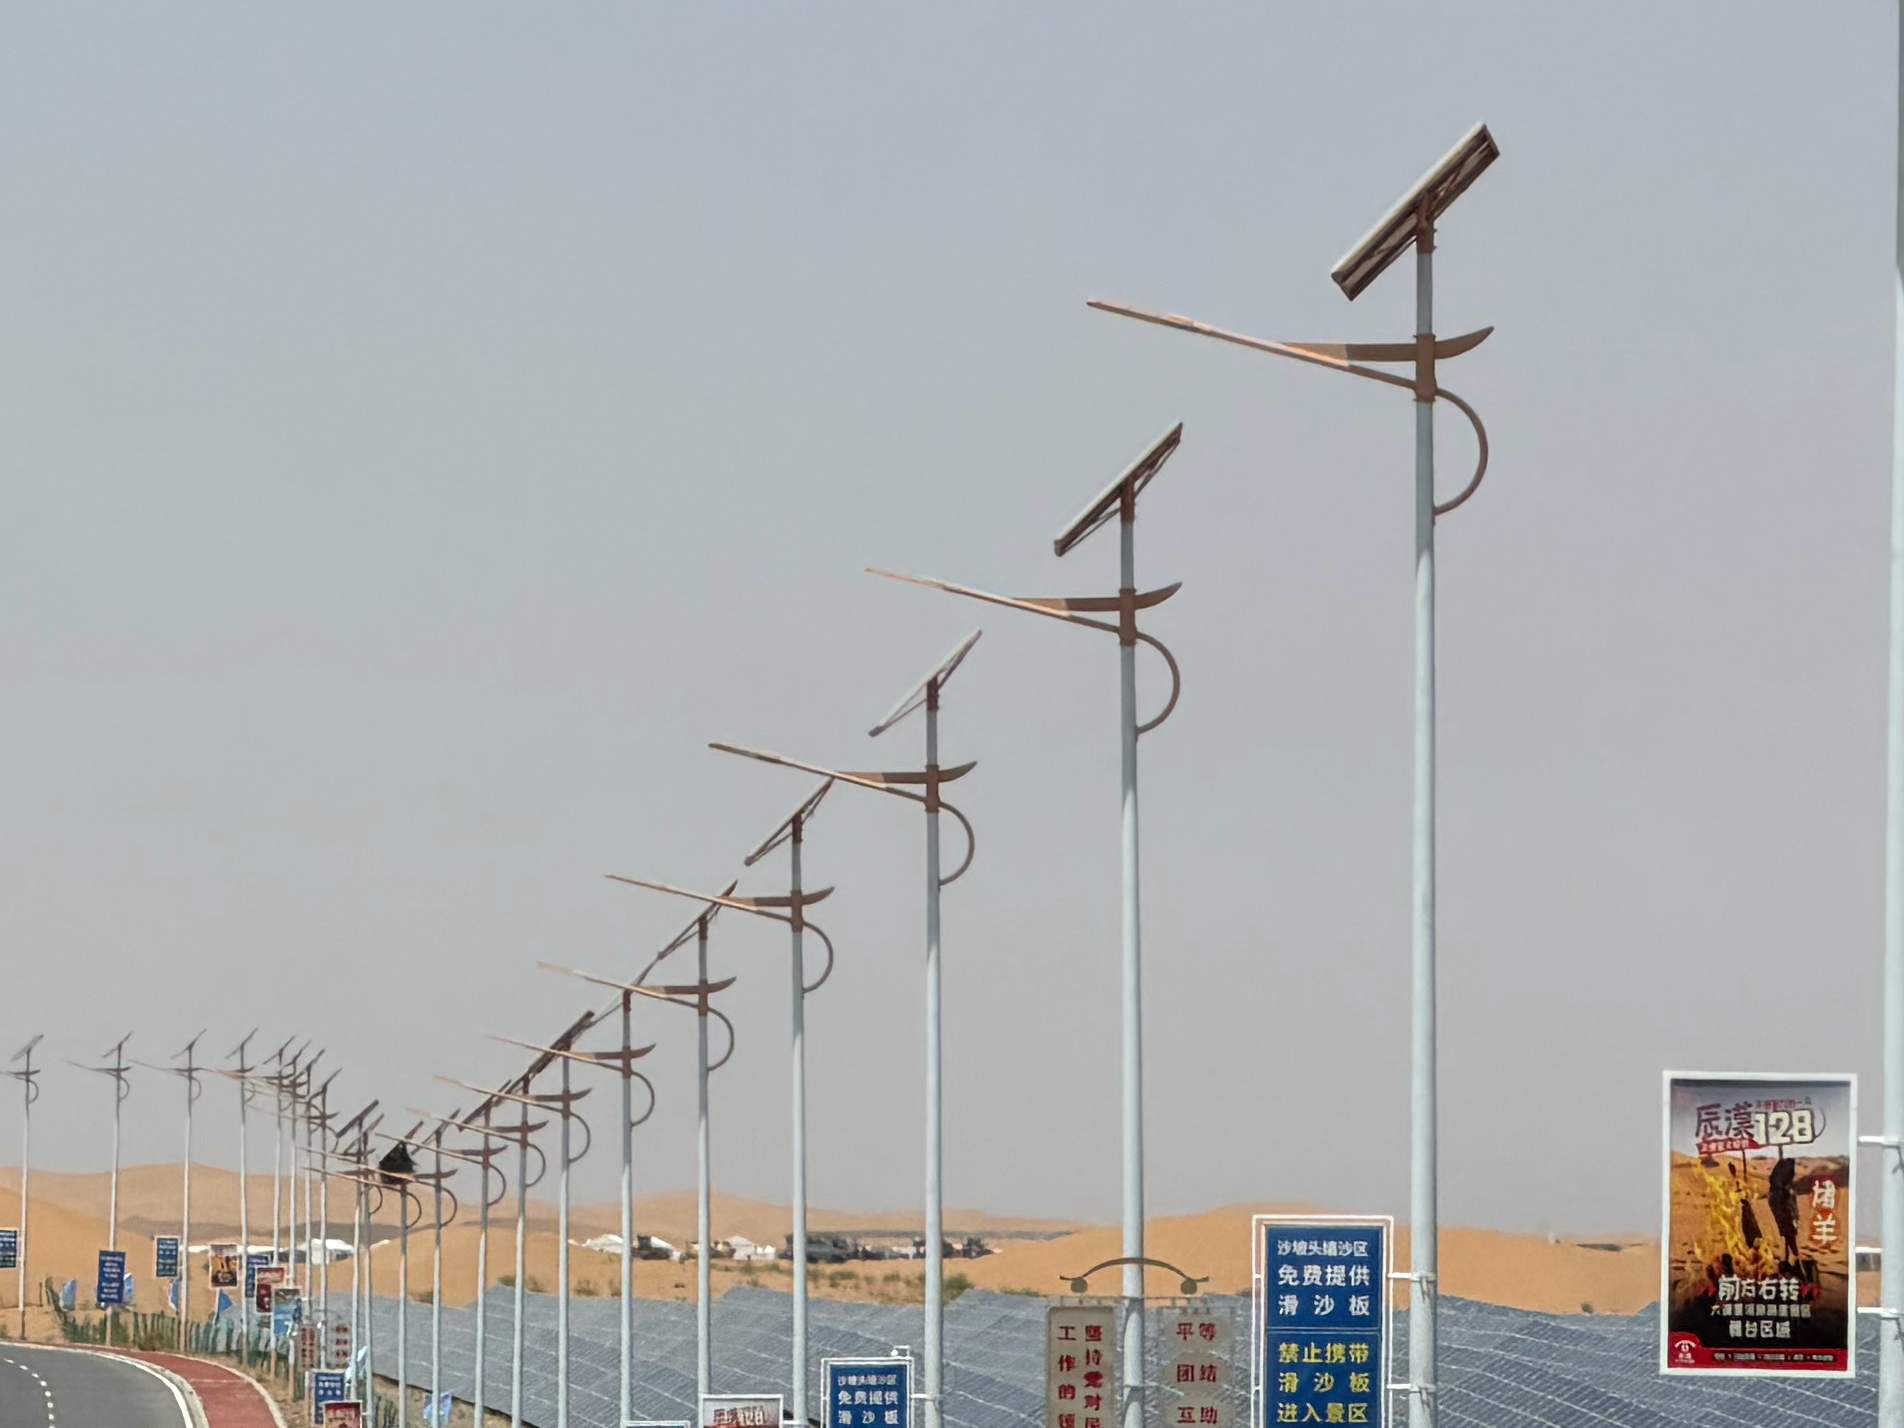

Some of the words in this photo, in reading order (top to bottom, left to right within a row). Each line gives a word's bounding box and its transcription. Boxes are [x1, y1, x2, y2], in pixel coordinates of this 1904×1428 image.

[1277, 1264, 1371, 1287] 免费提供
[1718, 1274, 1801, 1301] 前方右转
[1277, 1294, 1371, 1316] 滑沙板
[1176, 1322, 1217, 1341] 平等
[1278, 1342, 1370, 1364] 禁止携带
[1176, 1364, 1218, 1383] 团结
[1278, 1371, 1371, 1393] 滑沙板
[1176, 1406, 1218, 1425] 互助
[1277, 1402, 1369, 1423] 进入景区
